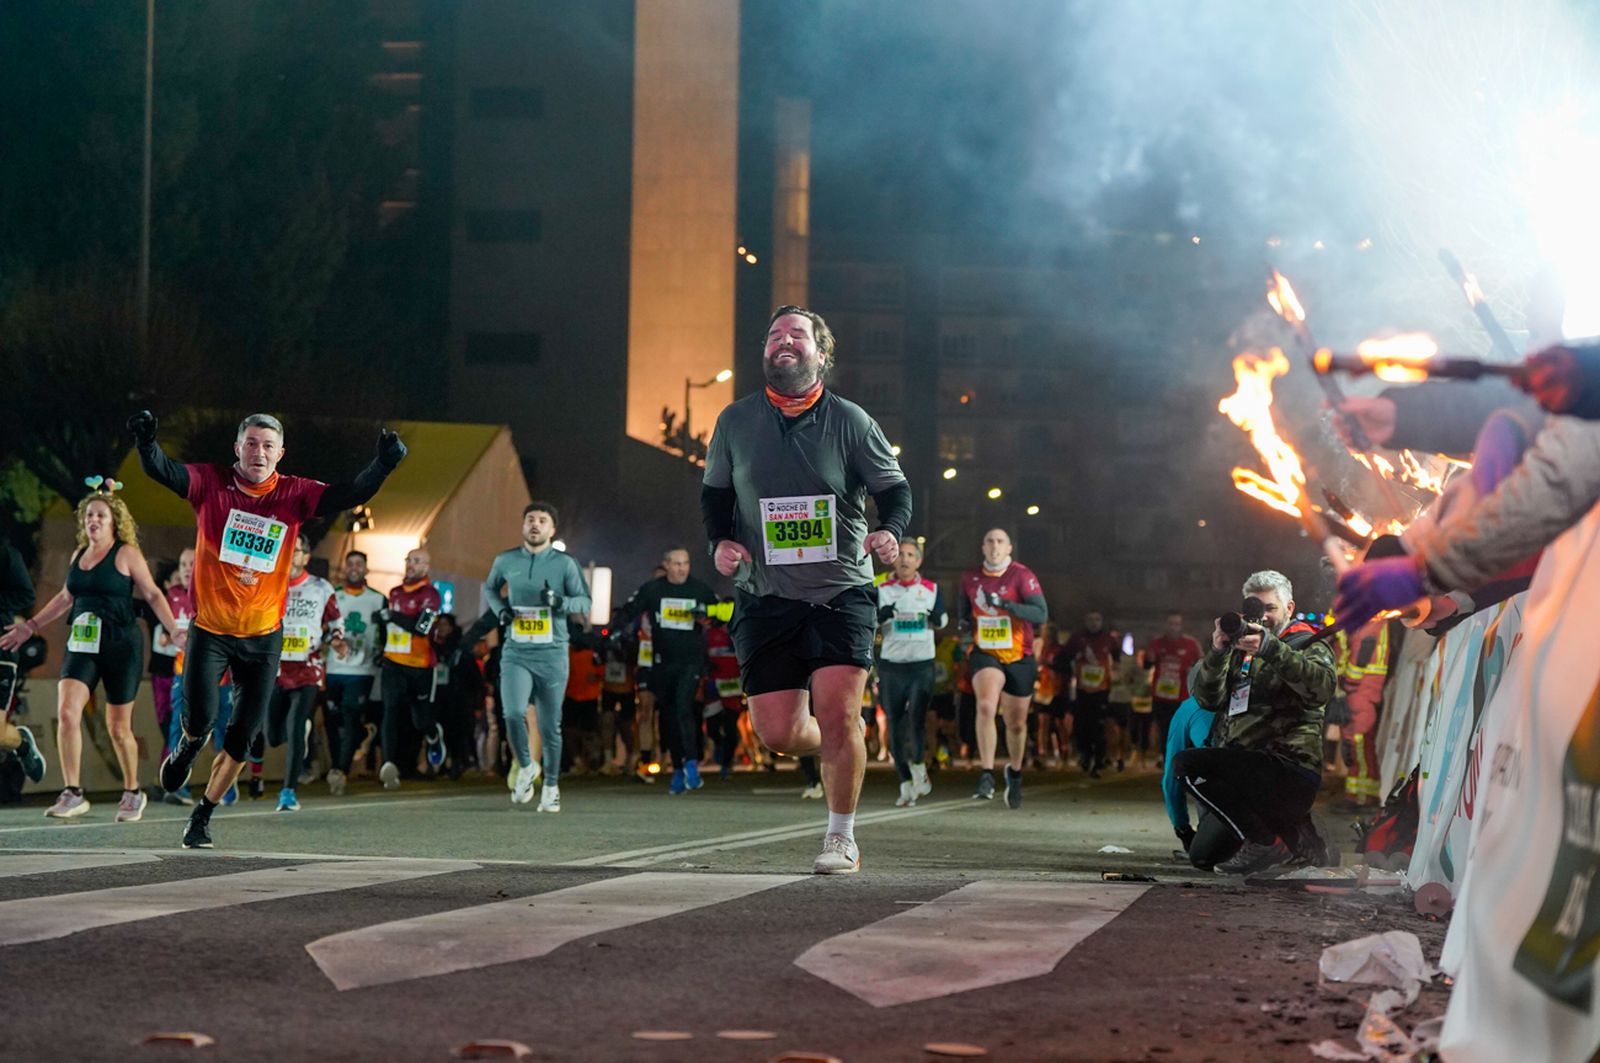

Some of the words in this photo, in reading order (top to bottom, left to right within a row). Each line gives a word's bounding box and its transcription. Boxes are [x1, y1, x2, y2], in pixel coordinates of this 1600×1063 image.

[776, 504, 798, 512] NOCHE
[799, 503, 808, 511] DE
[768, 513, 783, 521] SAN
[774, 519, 824, 542] 3394
[229, 530, 275, 555] 13338
[519, 619, 544, 631] 8379
